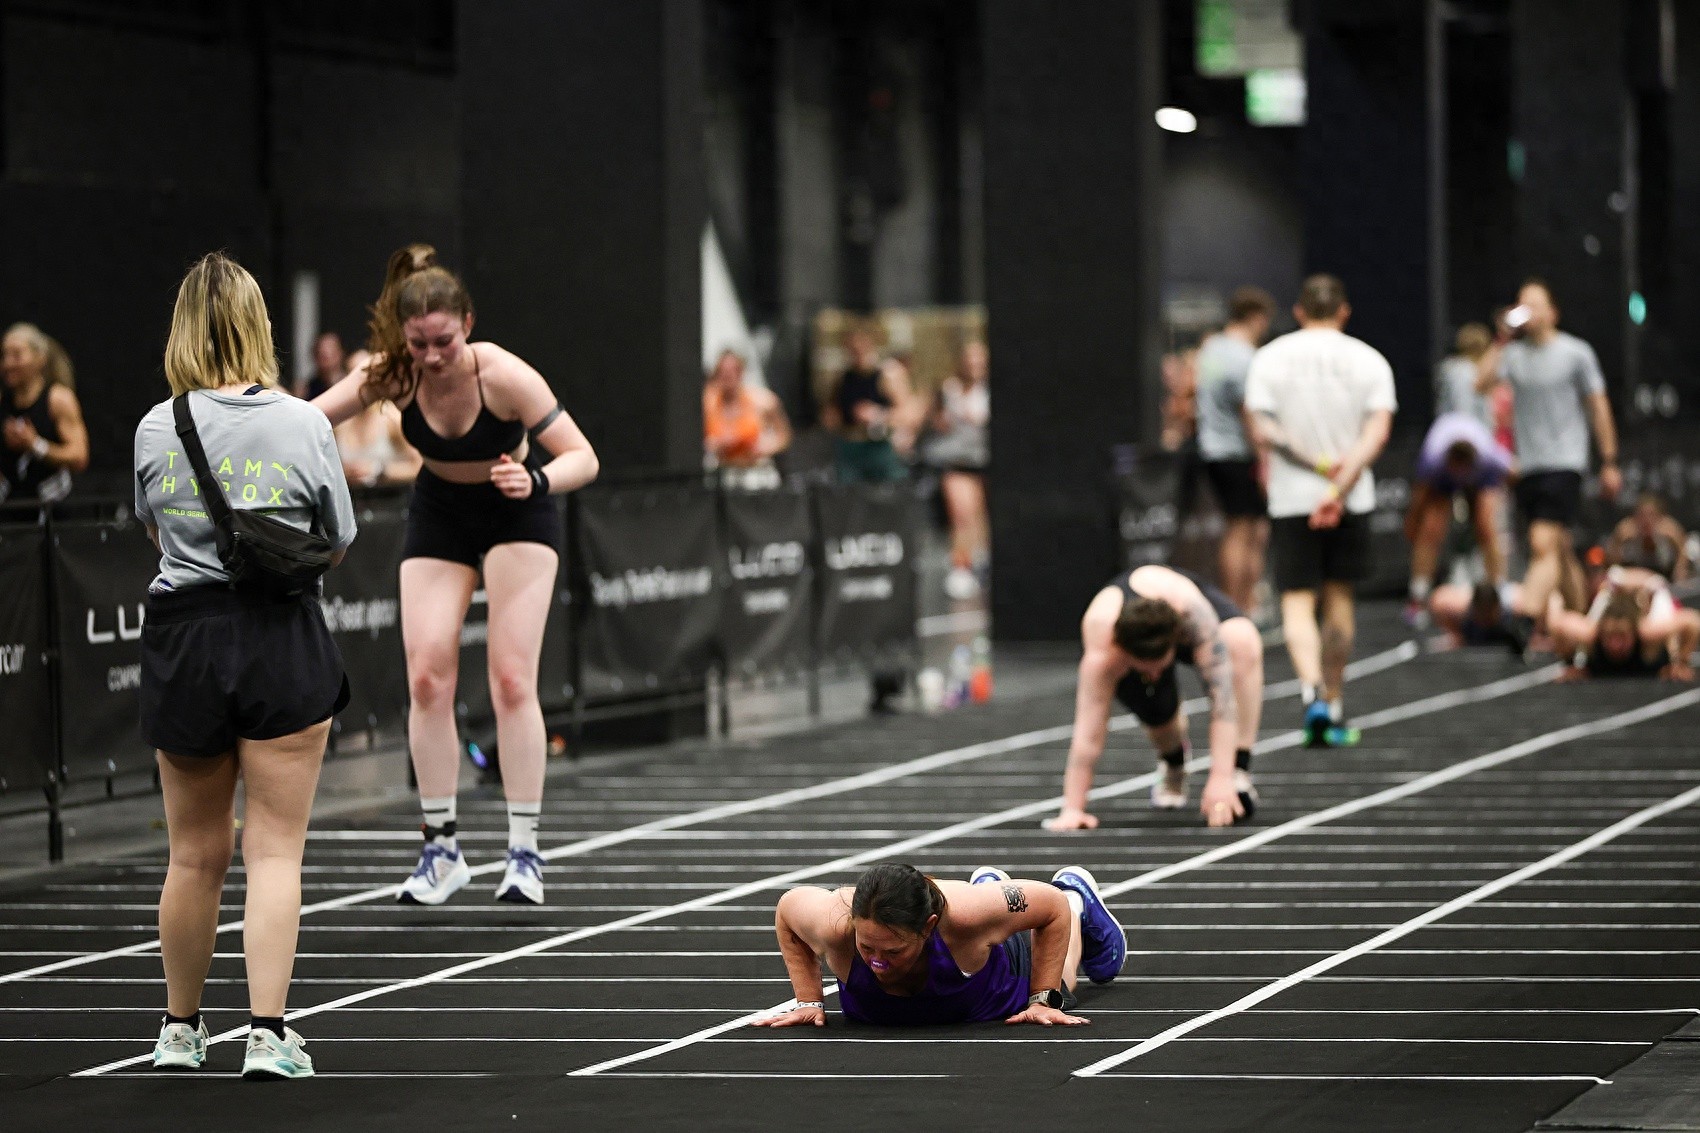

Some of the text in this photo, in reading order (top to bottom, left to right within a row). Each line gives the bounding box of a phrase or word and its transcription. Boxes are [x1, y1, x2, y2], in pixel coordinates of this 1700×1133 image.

[166, 451, 263, 478] TAM
[163, 507, 186, 516] WORLD
[86, 602, 146, 645] LU
